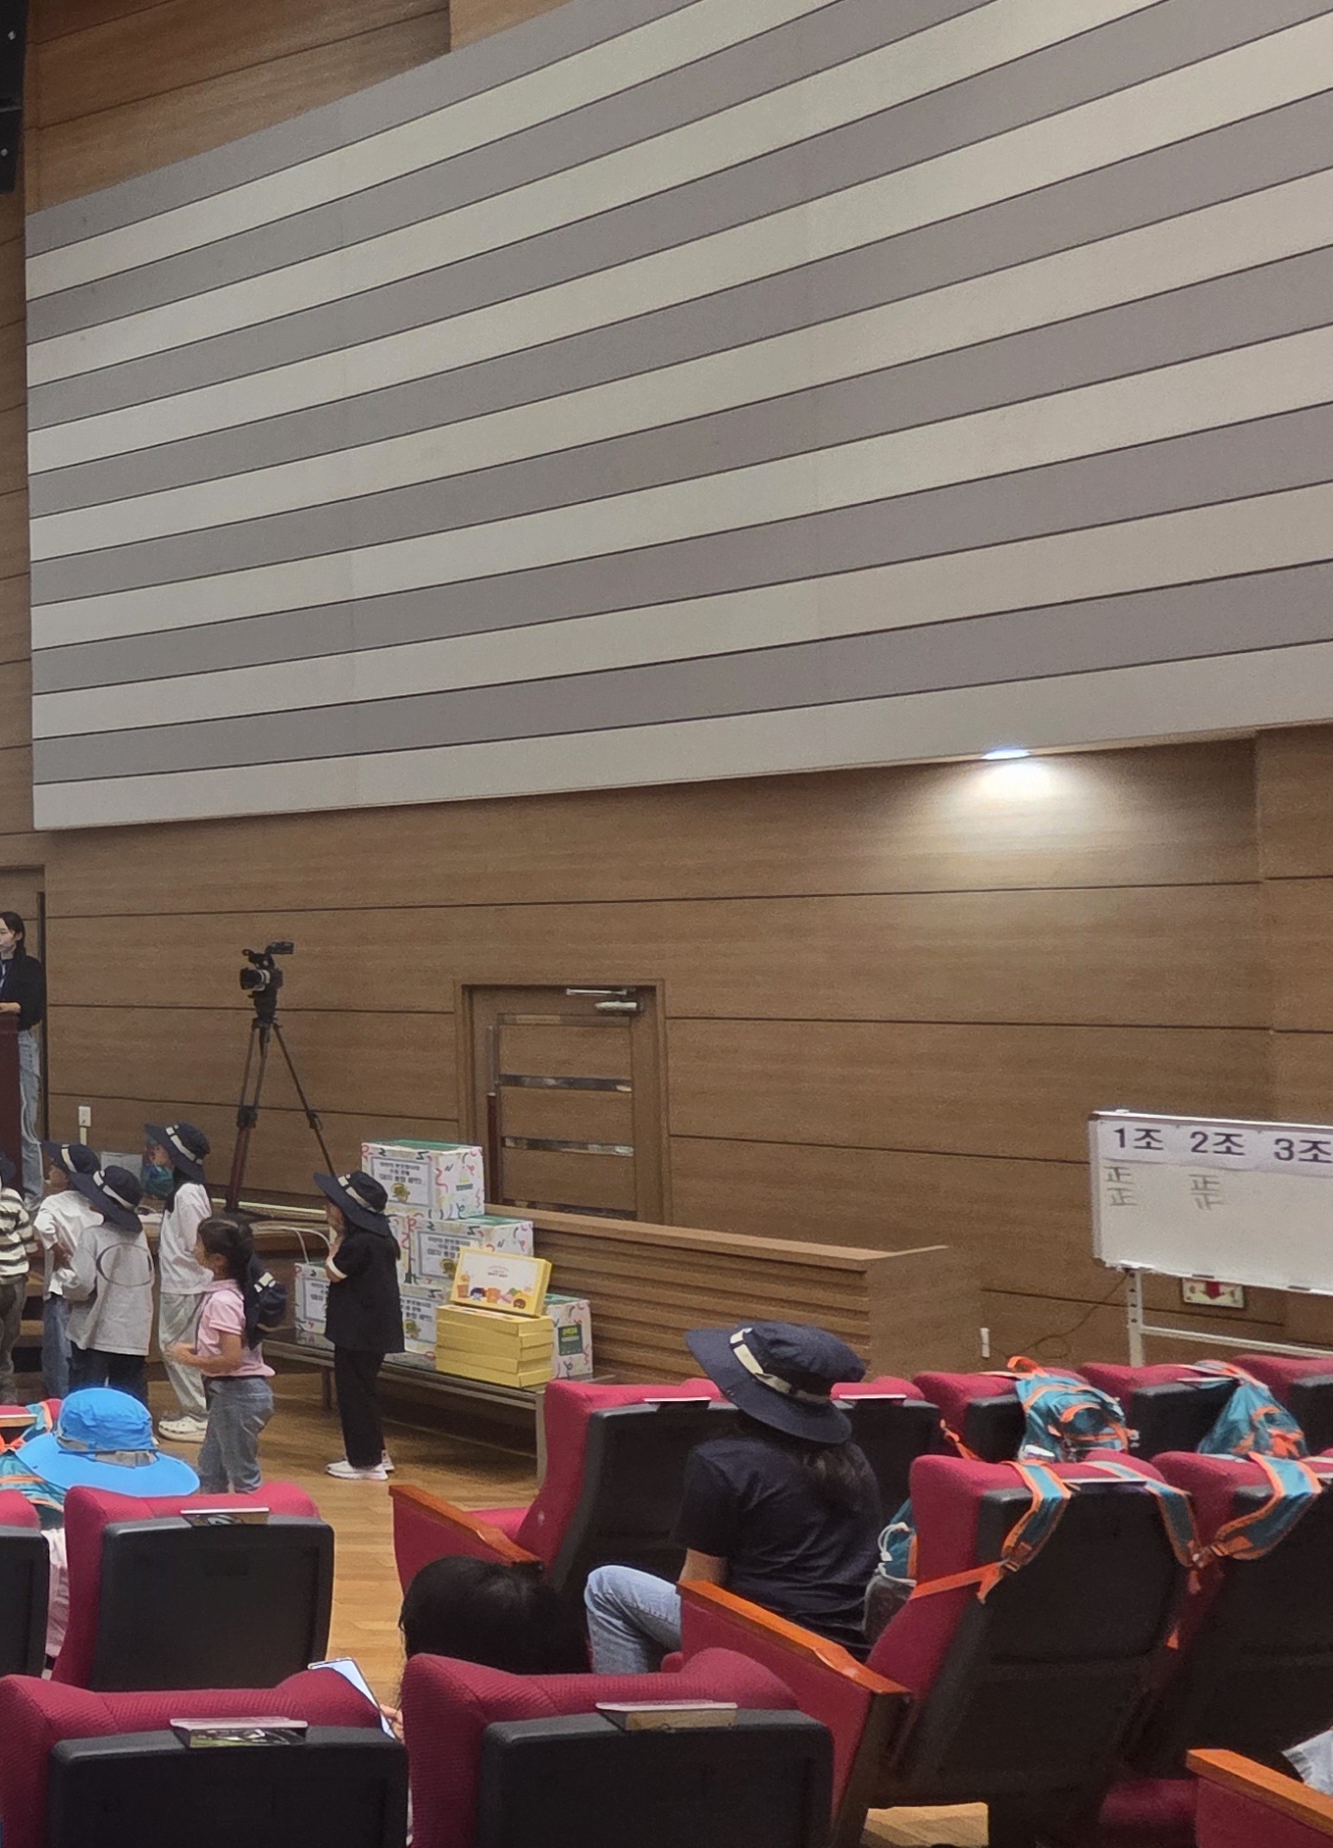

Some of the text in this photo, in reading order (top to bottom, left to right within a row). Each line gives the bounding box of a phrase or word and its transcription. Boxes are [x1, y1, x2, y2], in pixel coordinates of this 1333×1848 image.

[1114, 1127, 1333, 1164] 1조 2조 3조
